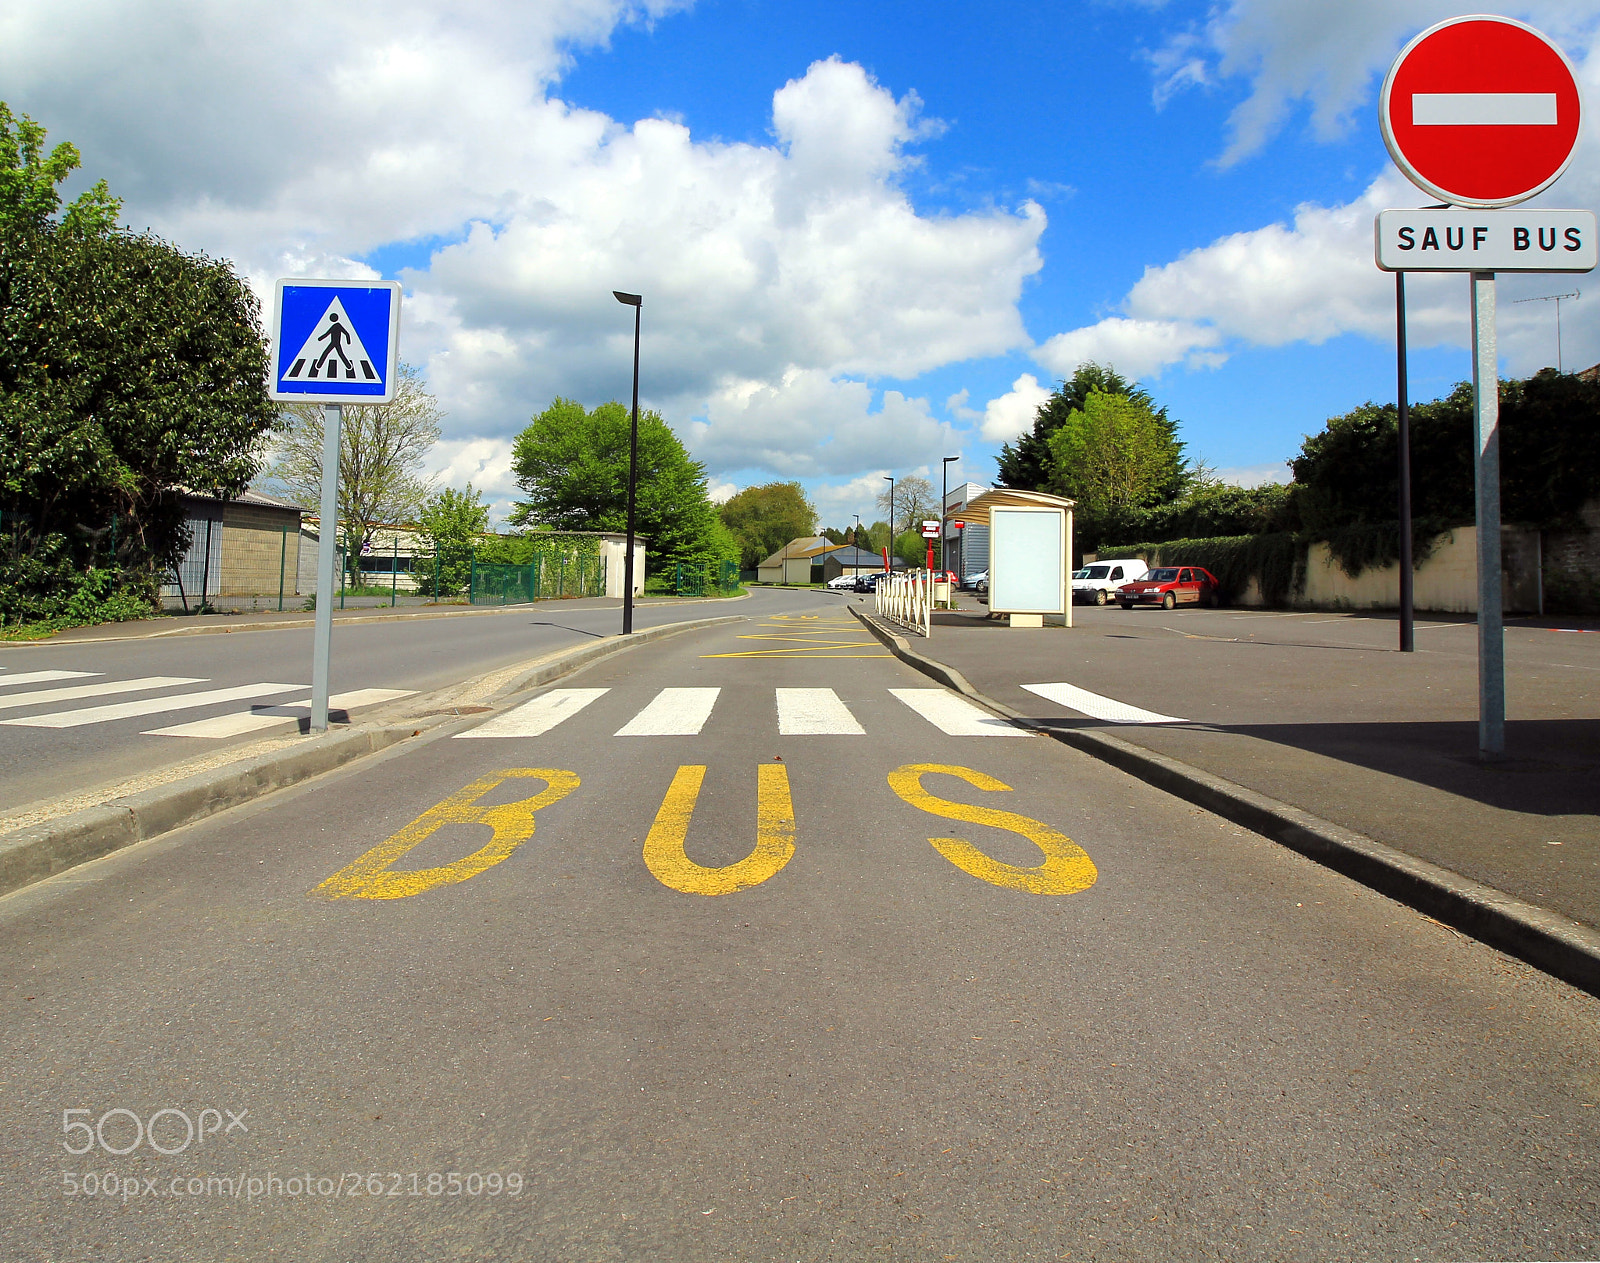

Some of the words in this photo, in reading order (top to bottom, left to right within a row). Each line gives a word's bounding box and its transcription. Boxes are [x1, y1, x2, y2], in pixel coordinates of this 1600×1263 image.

[1397, 226, 1489, 251] SAUF
[1513, 226, 1582, 252] BUS
[307, 762, 1099, 901] BUS
